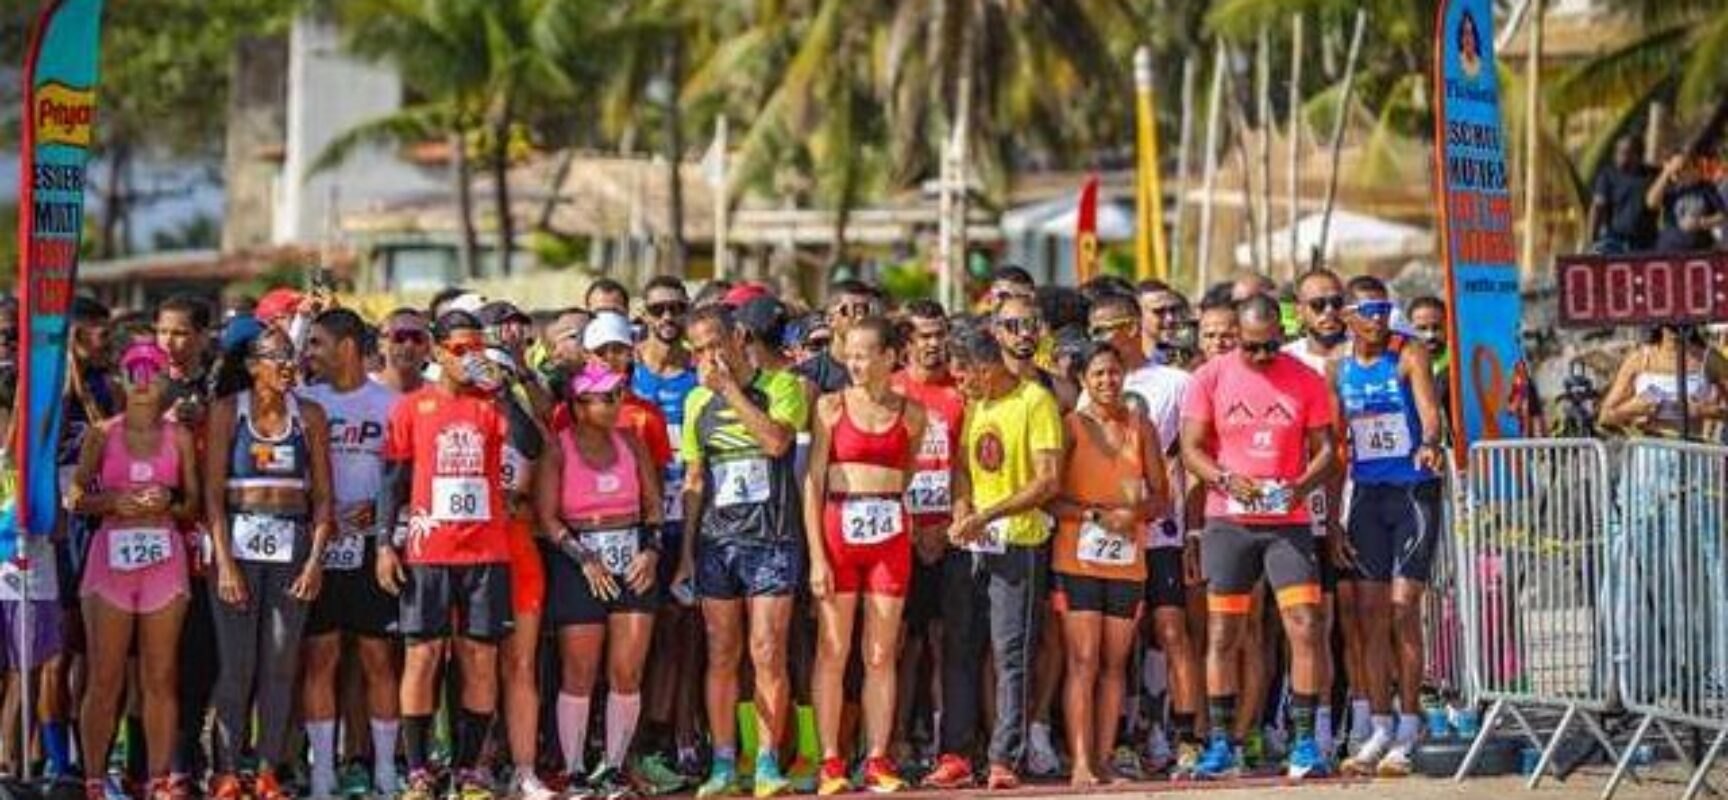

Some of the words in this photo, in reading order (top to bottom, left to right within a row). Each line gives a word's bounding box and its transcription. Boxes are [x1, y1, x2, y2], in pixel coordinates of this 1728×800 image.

[1369, 432, 1396, 450] 45
[451, 494, 476, 514] 80
[908, 487, 947, 508] 122
[851, 516, 893, 539] 214
[119, 545, 163, 564] 126
[248, 535, 278, 556] 46
[1096, 539, 1121, 559] 72
